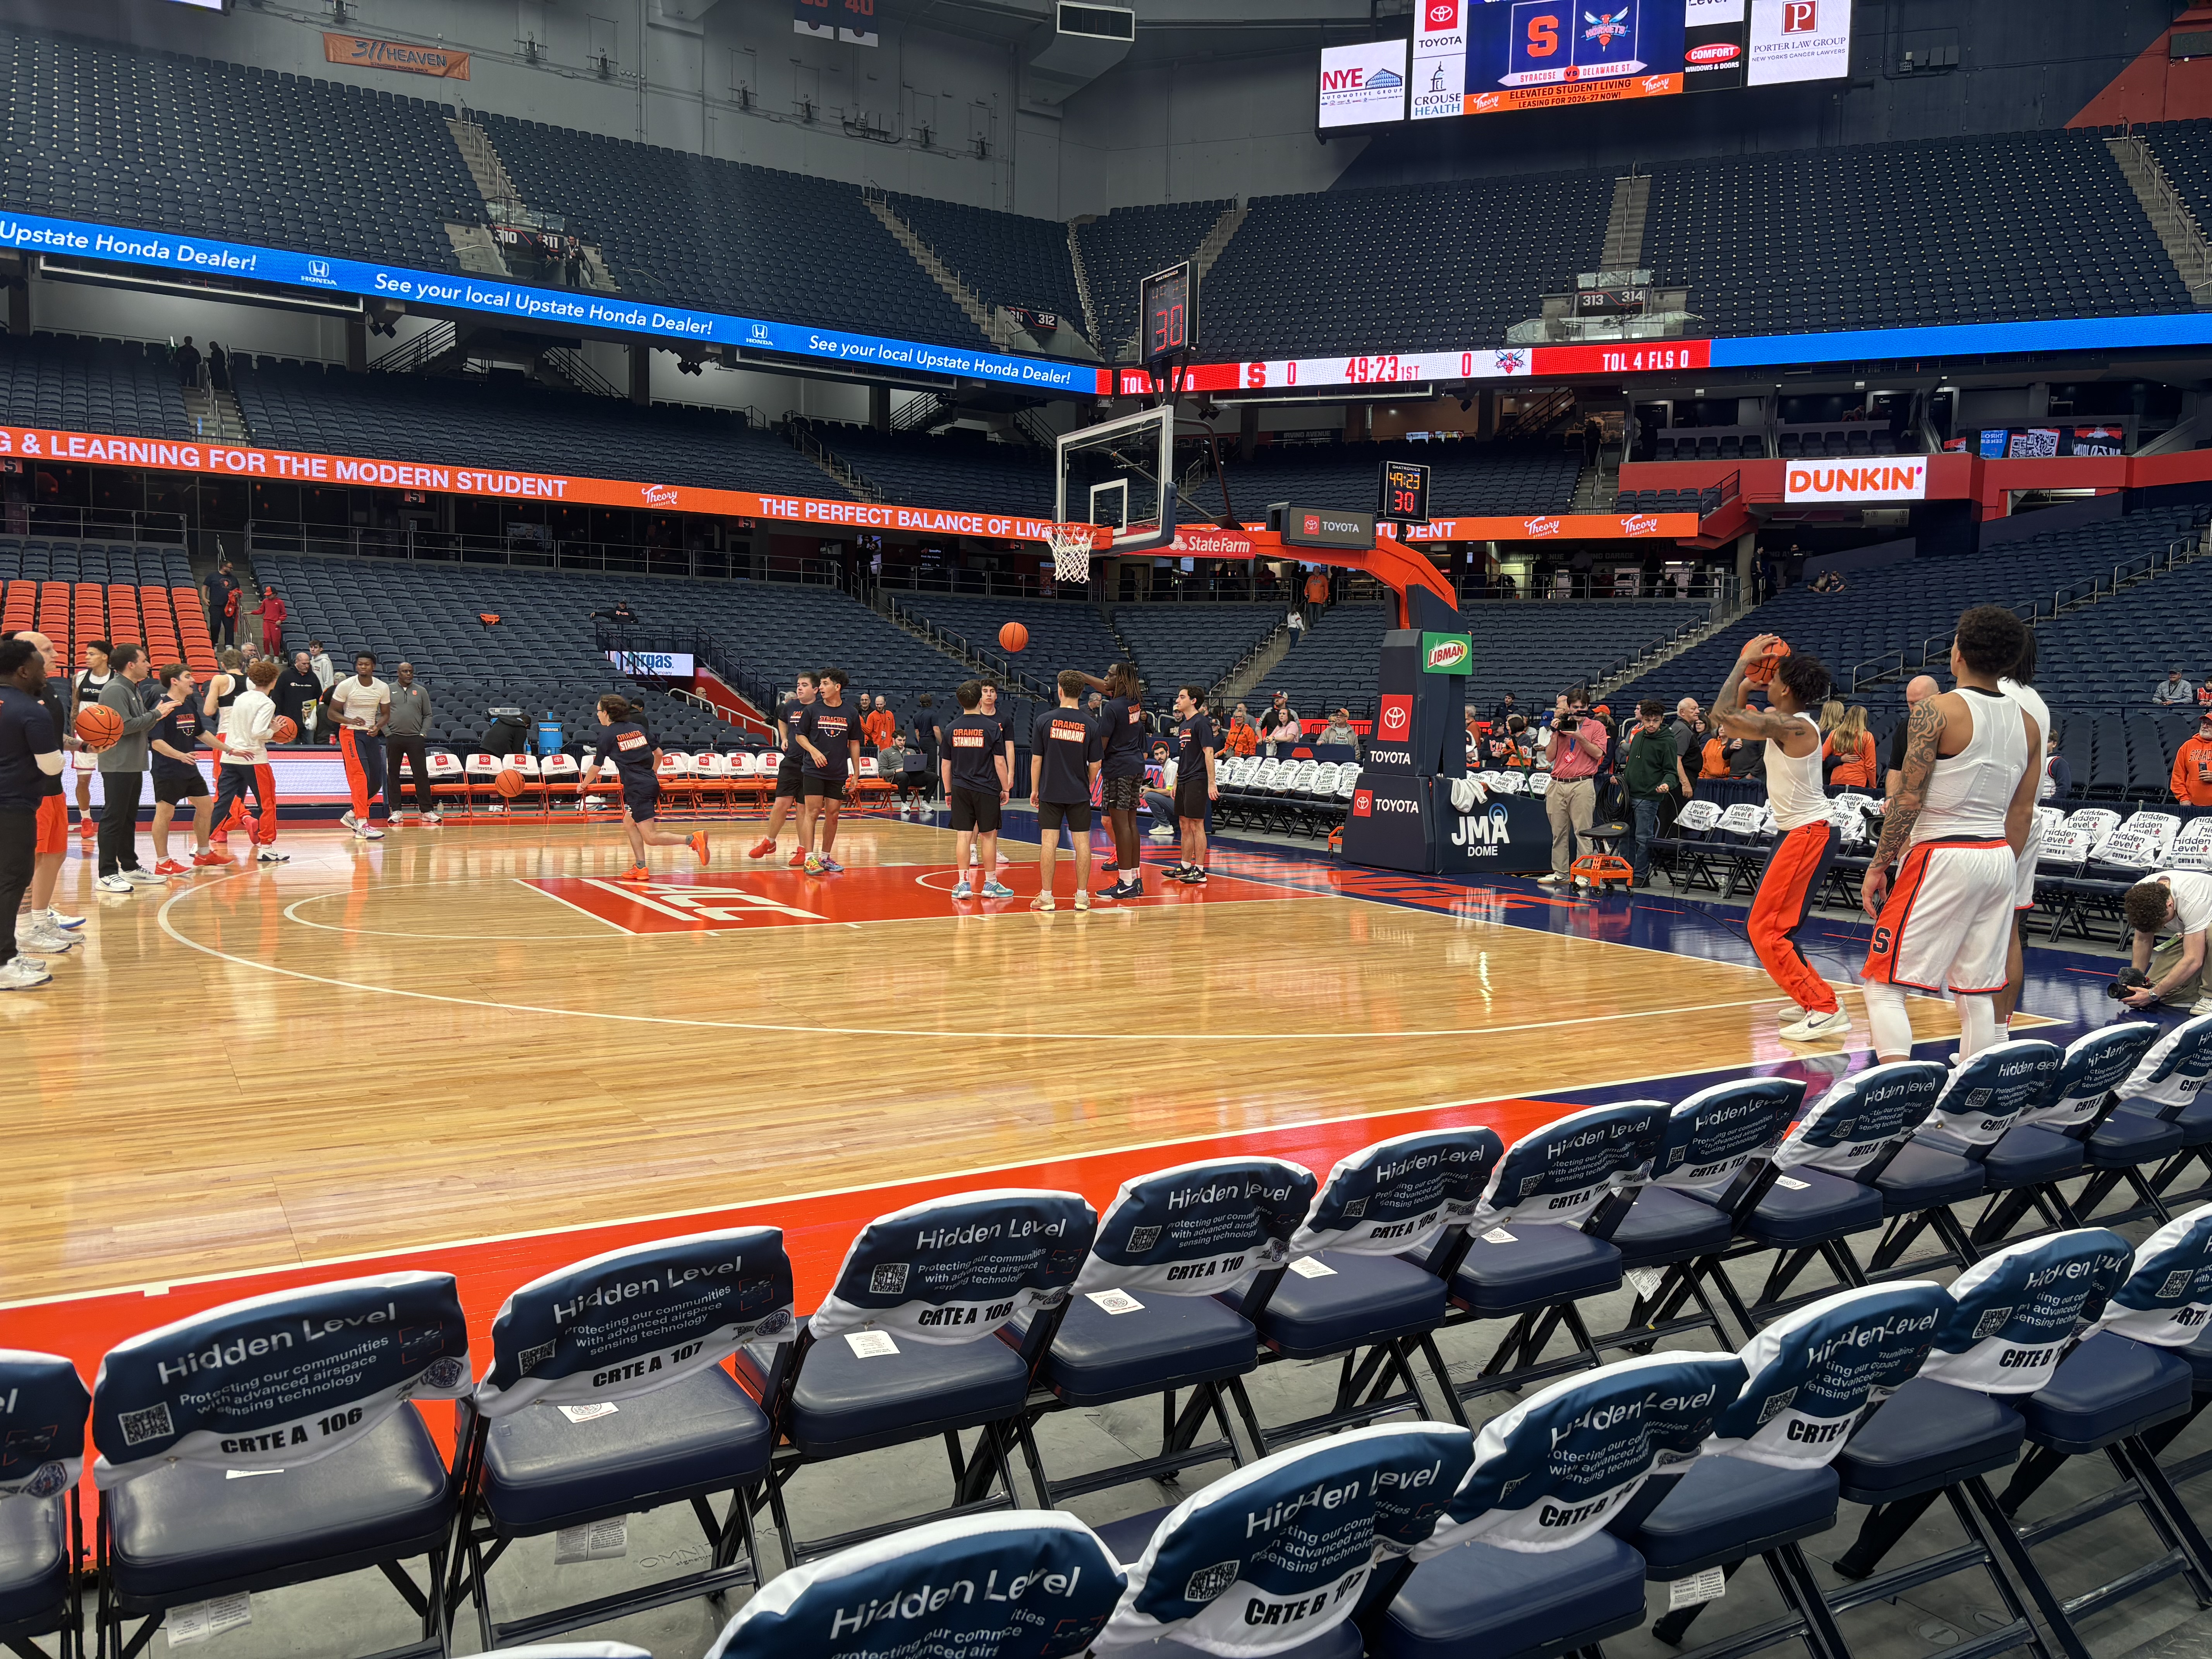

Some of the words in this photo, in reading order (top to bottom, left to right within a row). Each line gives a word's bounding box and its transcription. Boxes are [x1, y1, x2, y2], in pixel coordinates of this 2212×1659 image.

[1789, 3, 1812, 31] P
[1419, 36, 1462, 48] TOYOTA
[1527, 15, 1559, 58] S
[1754, 42, 1789, 53] PORTER
[1791, 40, 1811, 50] LAW
[1813, 37, 1846, 47] GROUP
[351, 40, 386, 60] 311
[387, 47, 447, 67] HEAVEN
[1691, 46, 1736, 60] COMFORT
[1817, 48, 1845, 57] LAWYERS
[1520, 71, 1556, 83] SYRACUSE
[1583, 65, 1620, 77] DELAWARE
[1622, 64, 1632, 72] ST.
[1685, 64, 1713, 73] WINDOWS
[1720, 61, 1739, 70] DOORS
[1322, 68, 1363, 90] NYE
[1642, 76, 1669, 93] Theory
[1321, 91, 1372, 100] AUTOMOTIVE
[1510, 87, 1554, 100] ELEVATED
[1556, 82, 1602, 95] STUDENT
[1604, 79, 1631, 90] LIVING
[1414, 93, 1461, 106] CROUSE
[1473, 93, 1499, 109] Theory
[1518, 99, 1549, 108] LEASING
[1567, 93, 1599, 104] 2026-27
[1601, 91, 1621, 100] NOW!
[1415, 103, 1460, 116] HEALTH
[495, 229, 517, 244] 310
[95, 234, 170, 259] Honda
[177, 245, 257, 272] Dealer!
[300, 275, 338, 287] HONDA
[1155, 270, 1178, 282] DAKTRONICS
[375, 273, 411, 294] See
[416, 282, 462, 299] your
[465, 286, 508, 307] local
[515, 295, 585, 318] Upstate
[589, 305, 647, 327] Honda
[652, 313, 713, 336] Dealer!
[1583, 294, 1604, 306] 313
[1621, 290, 1644, 302] 314
[1038, 310, 1054, 326] 312
[1155, 304, 1183, 352] 30
[745, 337, 774, 346] HONDA
[808, 335, 837, 352] See
[841, 342, 876, 358] your
[878, 344, 912, 362] local
[916, 348, 970, 371] Upstate
[974, 358, 1019, 378] Honda
[1023, 365, 1071, 385] Dealer!
[1462, 353, 1472, 377] 0
[1603, 352, 1626, 371] TOL
[1633, 352, 1642, 369] 4
[1648, 350, 1674, 370] FLS
[1680, 349, 1689, 368] 0
[1247, 362, 1266, 388] S
[1288, 362, 1297, 385] 0
[1345, 357, 1398, 384] 49:23
[1401, 365, 1419, 381] 1ST
[1123, 377, 1144, 393] TOL
[1187, 374, 1194, 390] 0
[1284, 430, 1304, 438] IRVING
[1305, 429, 1331, 438] AVENUE
[22, 433, 41, 454] &
[51, 434, 200, 467] LEARNING
[209, 448, 266, 473] FOR
[274, 454, 327, 478] THE
[336, 460, 449, 489] MODERN
[457, 472, 568, 498] STUDENT
[1389, 472, 1420, 489] 49:23
[1789, 466, 1922, 493] DUNKIN'
[641, 484, 677, 504] Theory
[1395, 491, 1414, 513] 30
[759, 498, 799, 517] THE
[805, 502, 893, 525] PERFECT
[898, 510, 983, 534] BALANCE
[988, 519, 1011, 534] OF
[1621, 514, 1657, 534] Theory
[1322, 521, 1359, 533] TOYOTA
[1376, 522, 1456, 539] TUDENT
[1524, 516, 1559, 535] Theory
[1188, 536, 1250, 553] StateFarm
[1427, 644, 1464, 668] LIBMAN
[1052, 719, 1085, 732] ORANGE
[616, 730, 642, 740] ORANGE
[953, 737, 984, 747] STANDARD
[1050, 727, 1085, 742] STANDARD
[618, 736, 647, 751] STANDARD
[1370, 750, 1411, 764] TOYOTA
[1376, 799, 1419, 813] TOYOTA
[1690, 807, 1707, 817] Level
[1692, 801, 1713, 812] Hidden
[1731, 809, 1747, 817] Level
[1733, 804, 1755, 814] Hidden
[1451, 816, 1510, 845] JMA
[2042, 834, 2066, 844] Level
[2045, 828, 2077, 839] Hidden
[2111, 831, 2145, 843] Hidden
[2108, 839, 2133, 850] Level
[2172, 836, 2211, 845] Hidden
[1468, 846, 1498, 856] DOME
[1872, 927, 1891, 953] S
[1376, 1152, 1437, 1183] Hidden
[1440, 1145, 1484, 1163] Level
[1168, 1185, 1238, 1211] Hidden
[916, 1224, 1001, 1250] Hidden
[1008, 1218, 1066, 1239] Level
[1166, 1262, 1205, 1281] CRTE
[1206, 1261, 1215, 1275] A
[1221, 1255, 1245, 1273] 110
[553, 1278, 659, 1324] Hidden
[668, 1255, 742, 1288] Level
[565, 1316, 629, 1336] Protecting
[632, 1308, 652, 1320] our
[655, 1285, 731, 1314] communities
[918, 1308, 963, 1326] CRTE
[964, 1307, 977, 1324] A
[984, 1301, 1013, 1321] 108
[576, 1334, 605, 1348] with
[607, 1318, 667, 1343] advanced
[670, 1302, 722, 1325] airspace
[590, 1335, 638, 1356] sensing
[641, 1313, 708, 1338] technology
[158, 1331, 292, 1385] Hidden
[303, 1302, 396, 1342] Level
[592, 1362, 645, 1388] CRTE
[649, 1356, 663, 1374] A
[672, 1341, 704, 1364] 107
[221, 1427, 286, 1453] CRTE
[291, 1425, 308, 1444] A
[318, 1407, 363, 1436] 106
[1246, 1481, 1360, 1539] Hidden
[830, 1579, 974, 1640] Hidden
[984, 1566, 1081, 1602] Level
[1245, 1597, 1306, 1626] CRTE
[1310, 1592, 1327, 1617] B
[1333, 1570, 1364, 1604] 107
